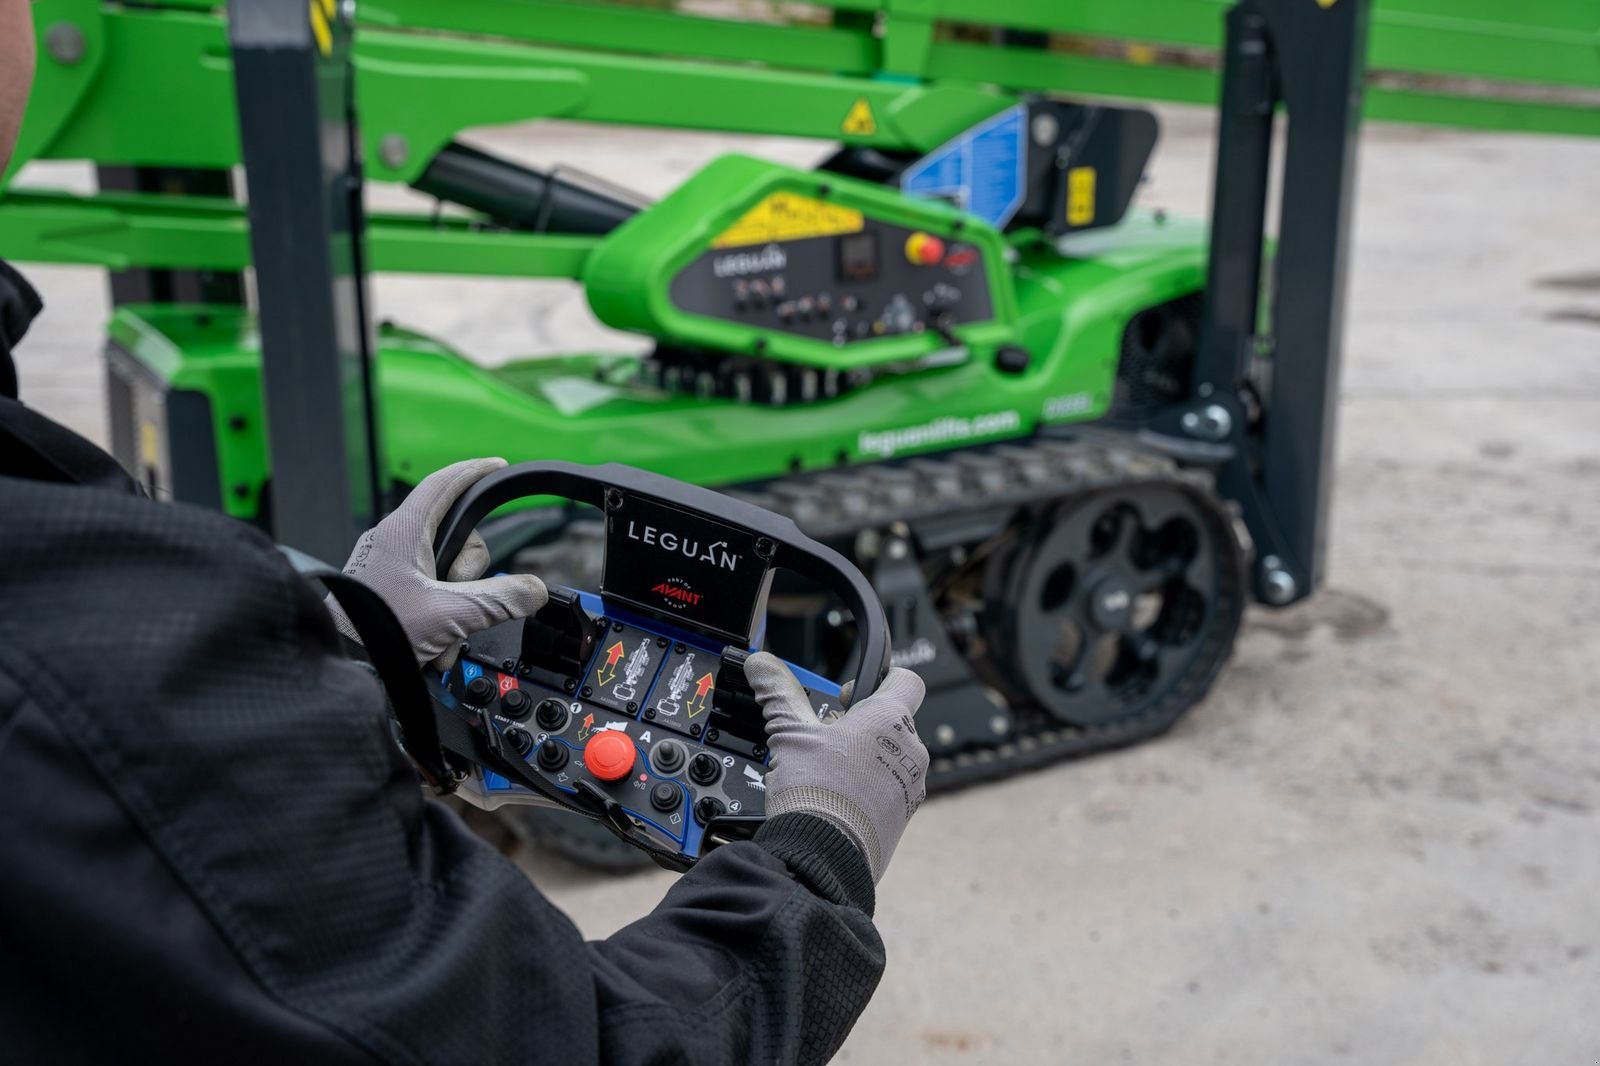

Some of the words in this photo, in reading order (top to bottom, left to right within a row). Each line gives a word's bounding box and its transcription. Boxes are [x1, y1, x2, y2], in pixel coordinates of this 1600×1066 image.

[857, 410, 1021, 457] leguanlifts.com
[628, 521, 737, 571] LEGUAN
[651, 583, 700, 605] AVANT
[494, 714, 510, 723] START
[639, 731, 651, 743] A
